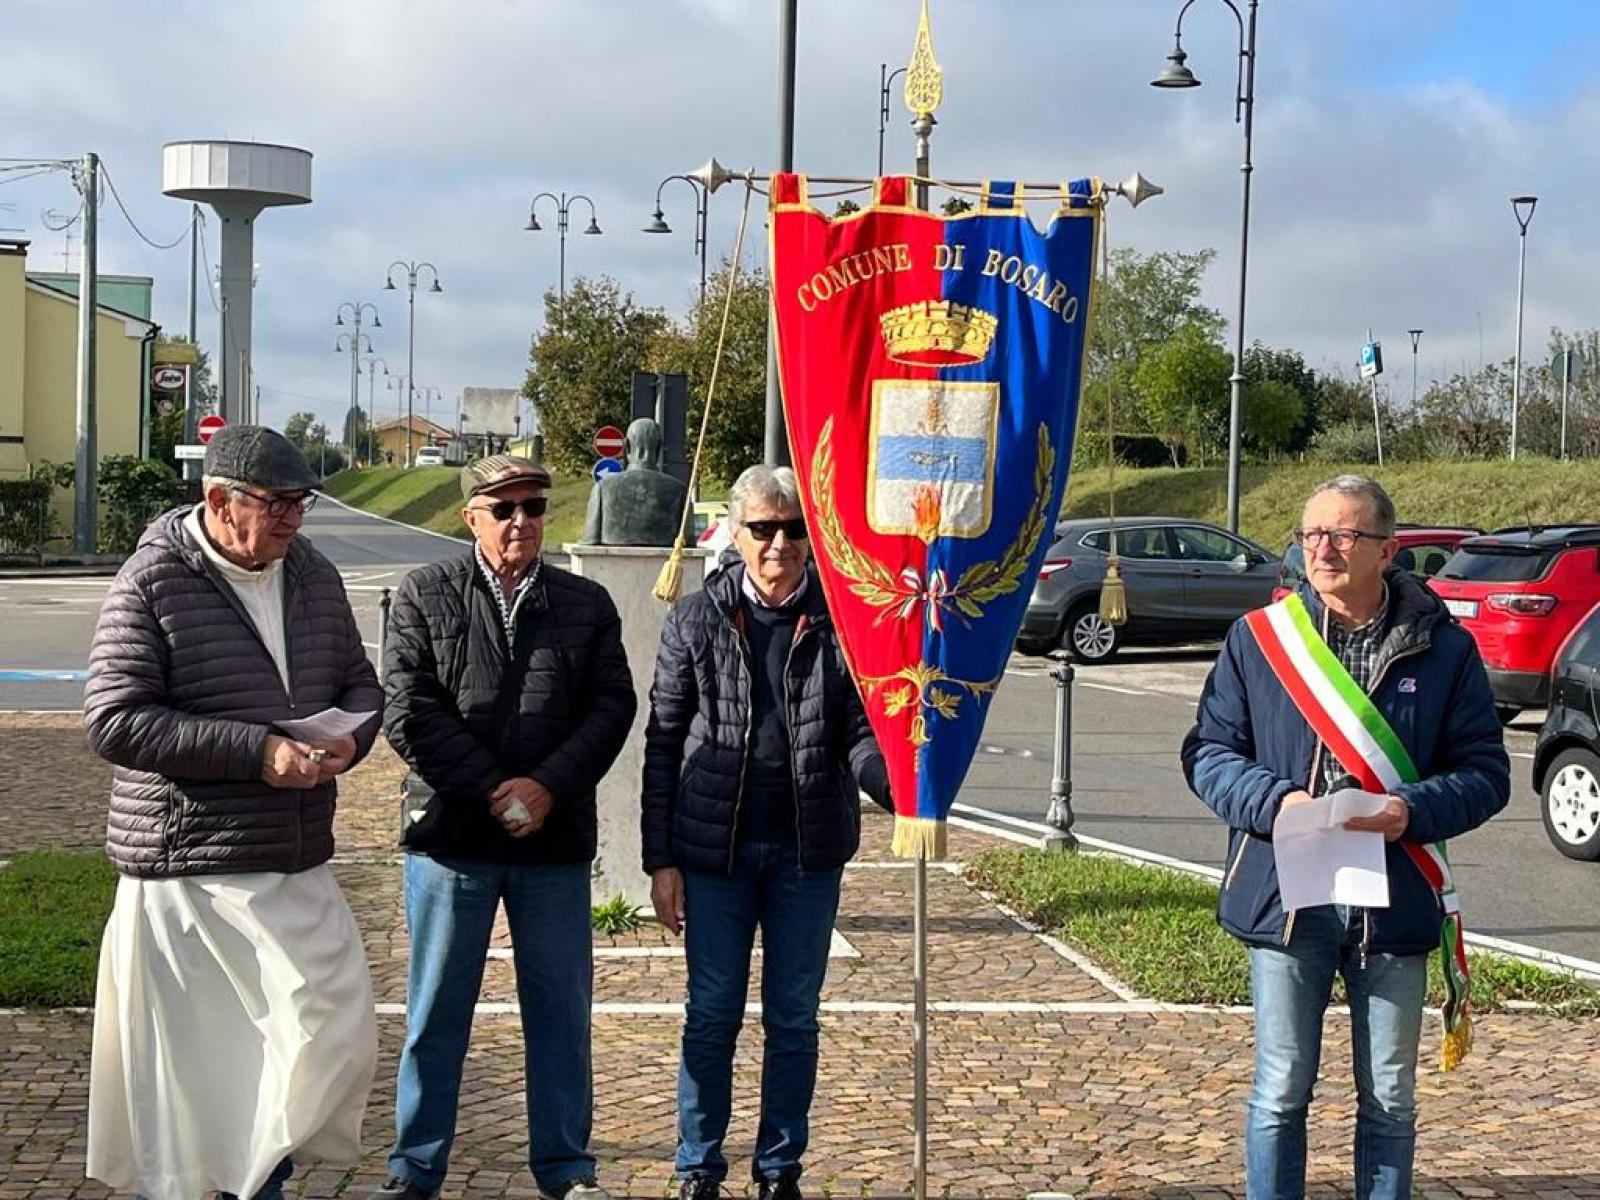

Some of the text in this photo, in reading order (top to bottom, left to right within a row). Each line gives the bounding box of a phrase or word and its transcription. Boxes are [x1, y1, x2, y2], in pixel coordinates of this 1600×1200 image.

[797, 244, 1079, 323] COMUNE DI BOSARO
